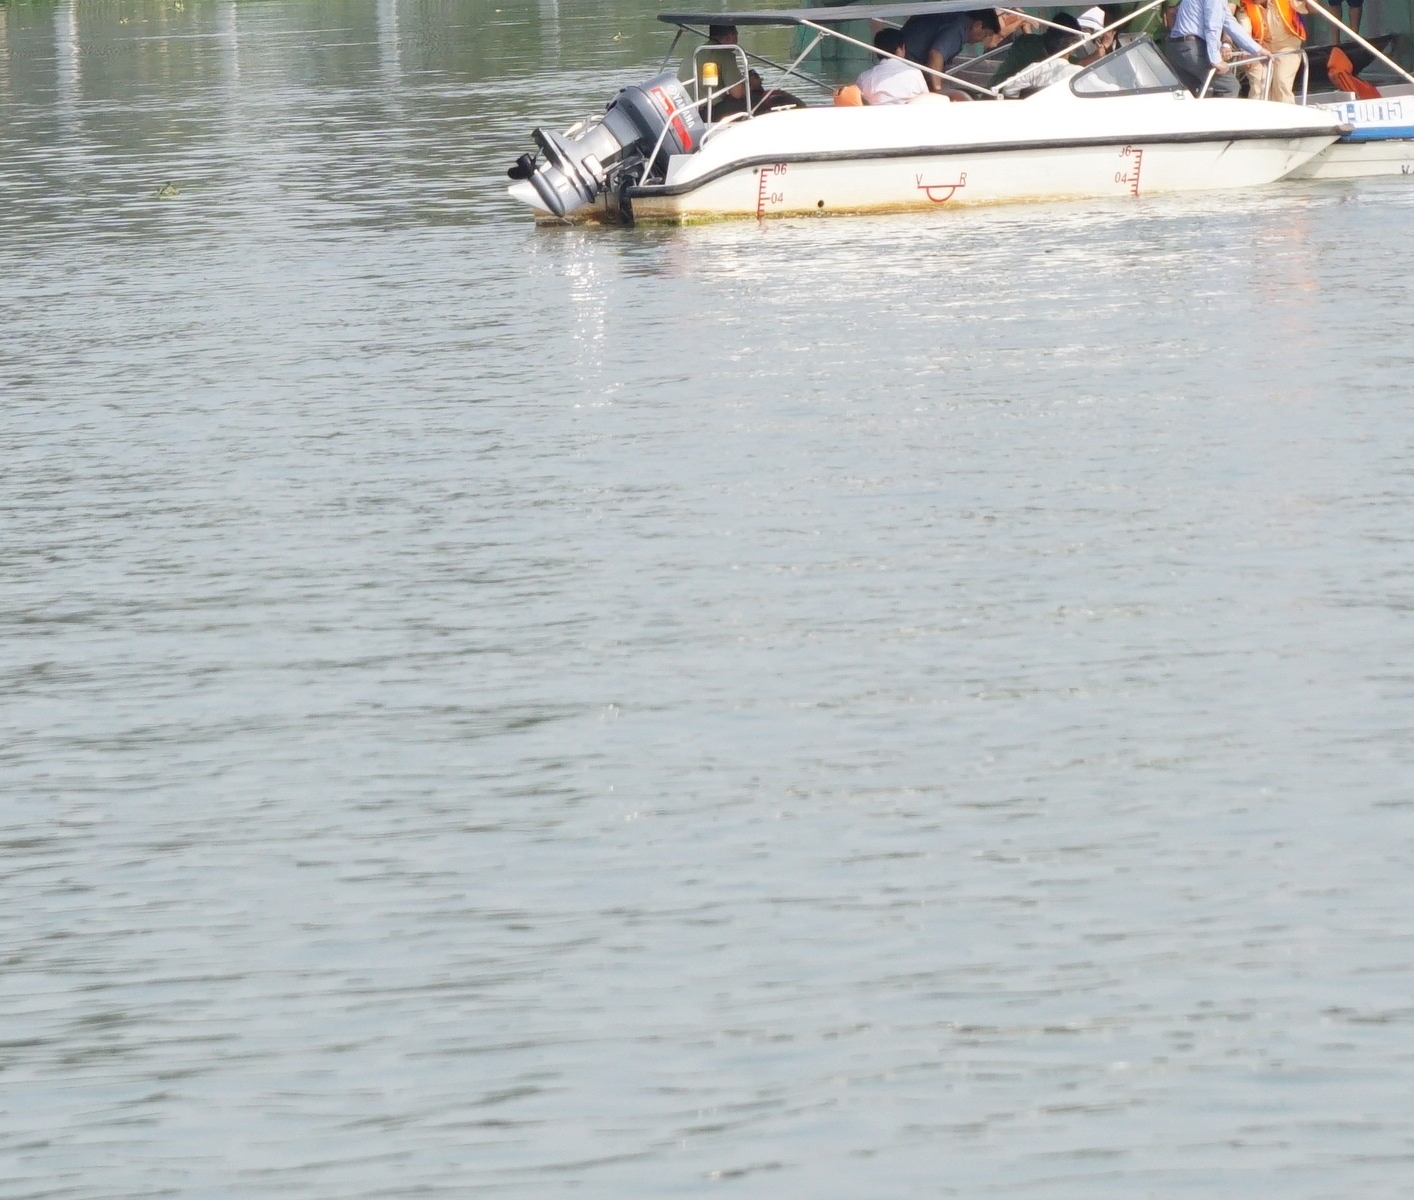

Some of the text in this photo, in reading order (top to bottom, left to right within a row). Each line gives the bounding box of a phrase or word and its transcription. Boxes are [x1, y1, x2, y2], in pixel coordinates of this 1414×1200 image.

[774, 163, 787, 175] 06
[916, 172, 967, 186] V R
[1115, 171, 1127, 184] 04
[771, 192, 783, 204] 04
